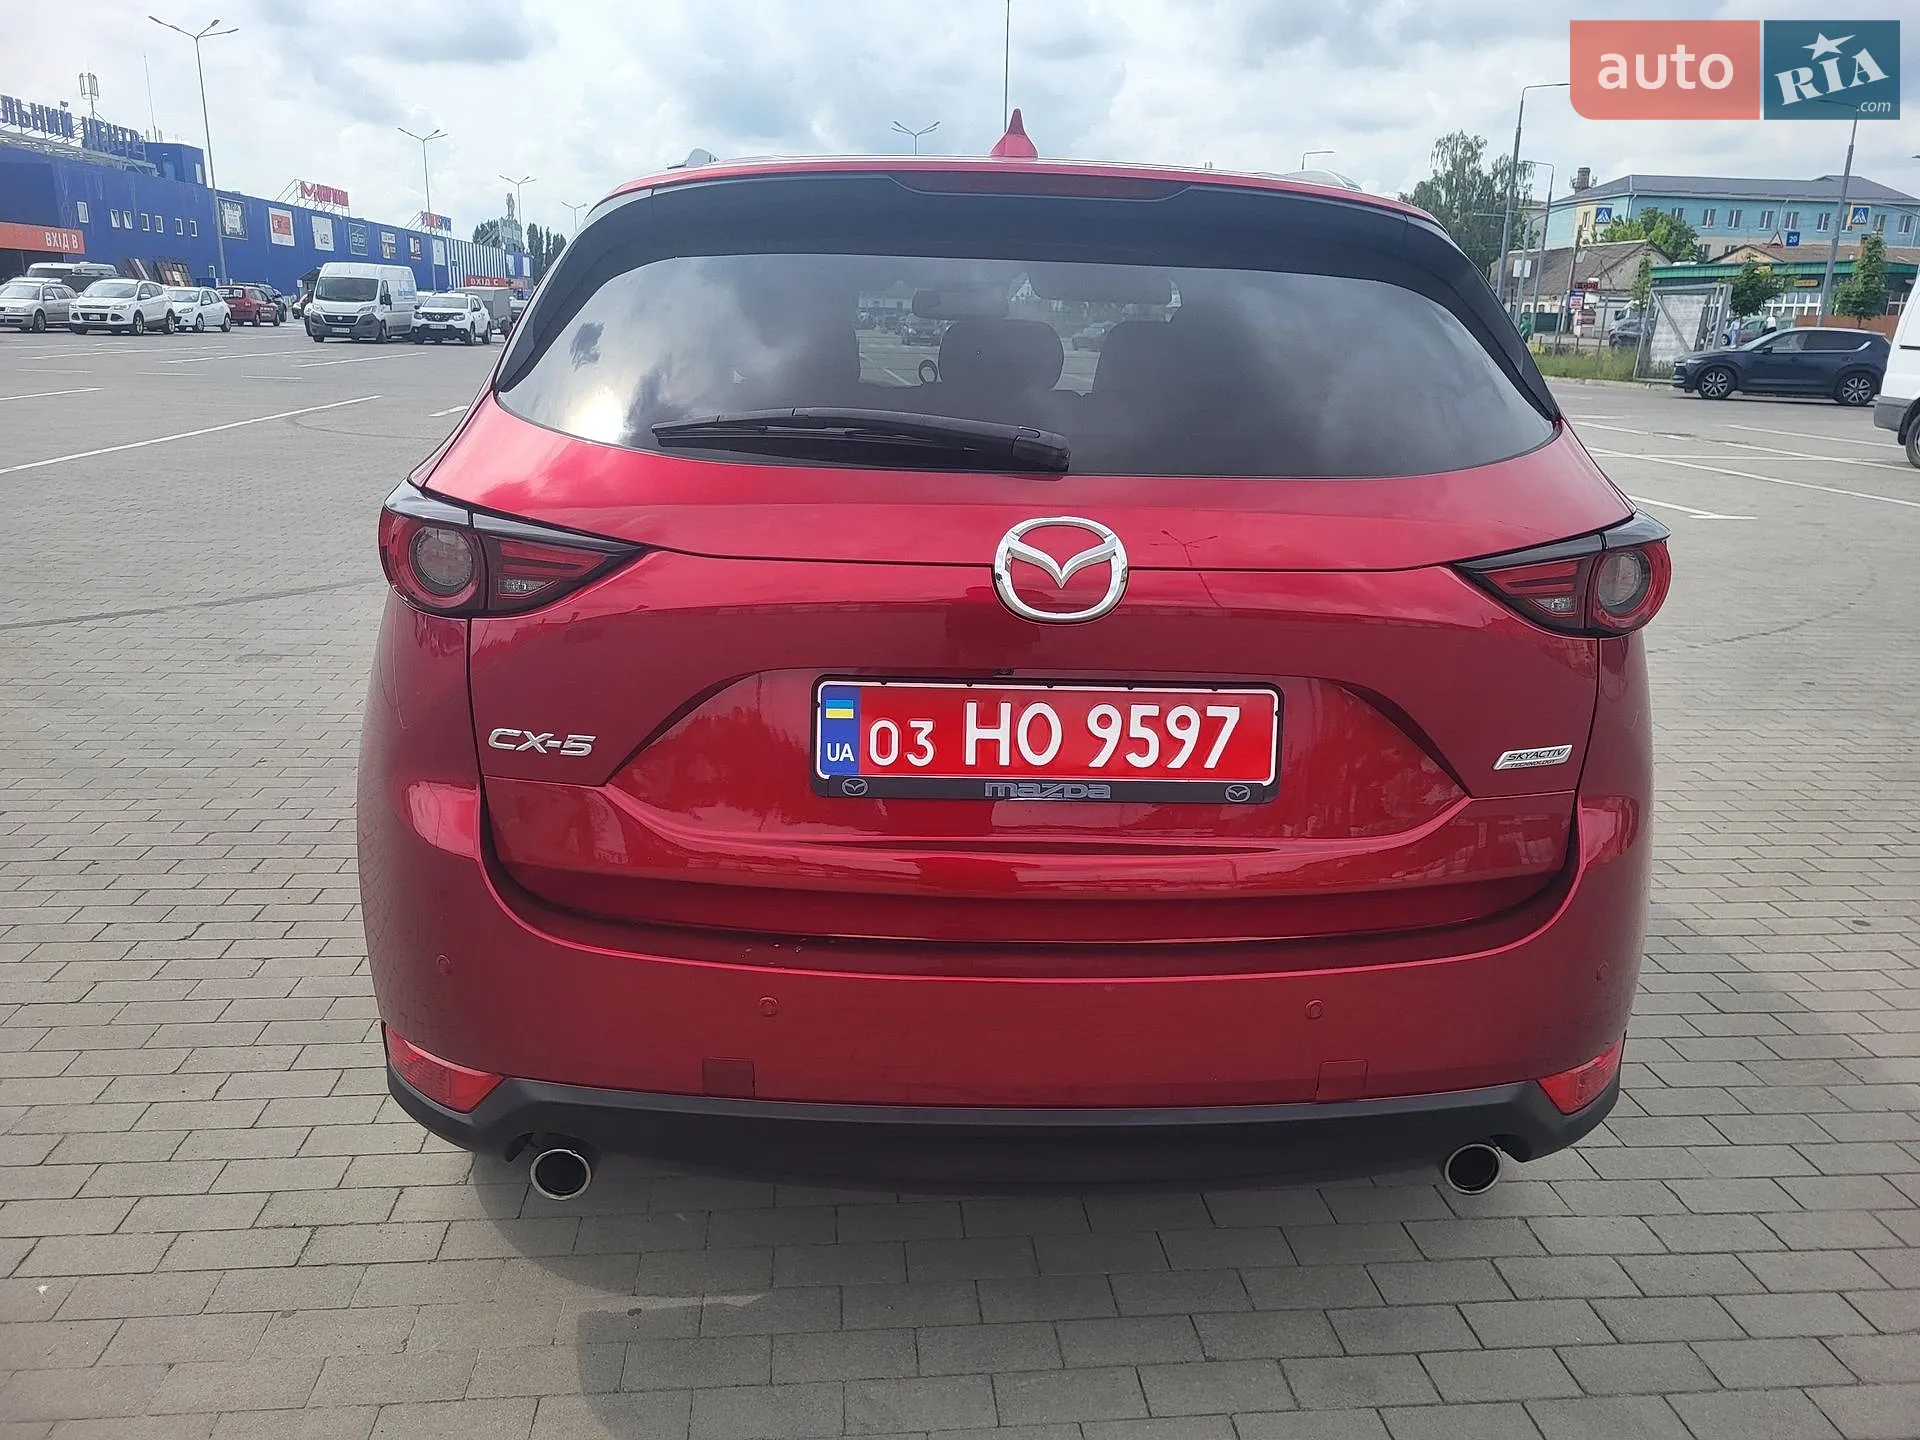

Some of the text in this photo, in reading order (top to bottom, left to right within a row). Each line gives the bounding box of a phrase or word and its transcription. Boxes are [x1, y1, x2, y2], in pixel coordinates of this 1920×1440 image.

[45, 231, 70, 251] ВХІД
[488, 728, 597, 757] CX-5
[868, 701, 1241, 769] 03 HO 9597
[826, 743, 855, 762] UA
[1507, 748, 1566, 761] SKYACTIV
